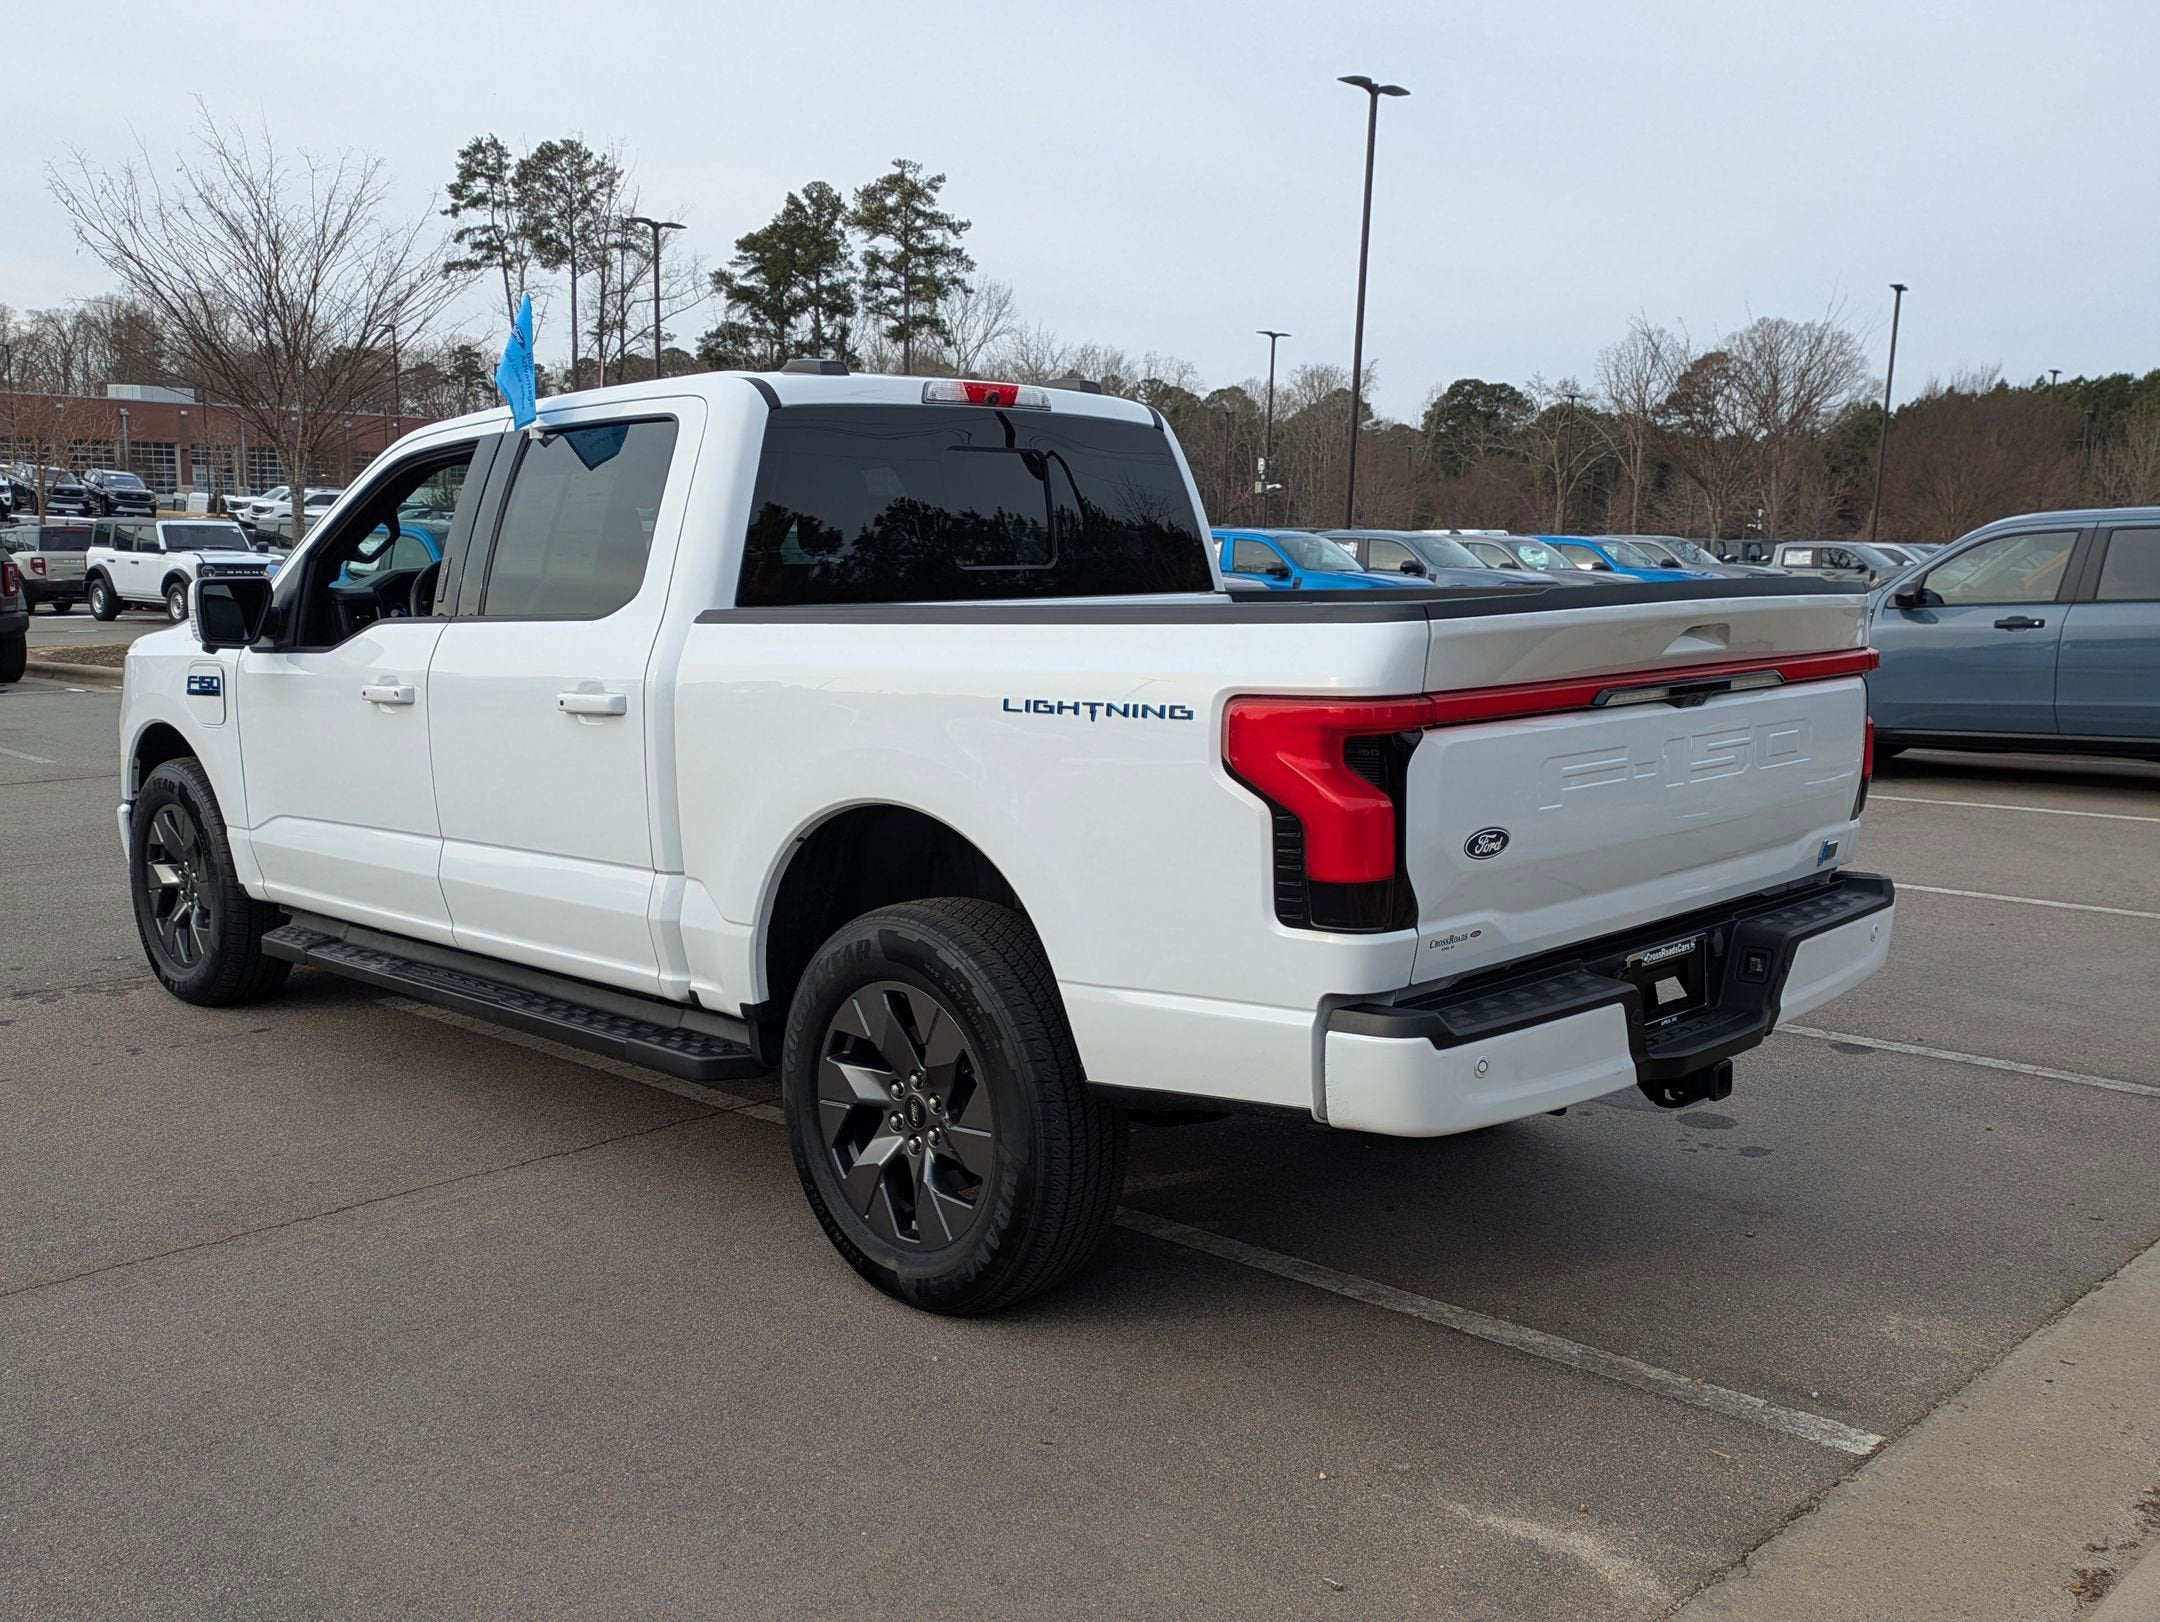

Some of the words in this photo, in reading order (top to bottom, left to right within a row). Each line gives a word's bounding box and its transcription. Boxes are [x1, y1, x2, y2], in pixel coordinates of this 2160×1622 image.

[526, 351, 534, 375] Blue
[519, 354, 534, 407] Advantage
[1002, 698, 1194, 723] LIGHTNING
[1538, 716, 1812, 812] F-150
[1474, 833, 1504, 855] Ford
